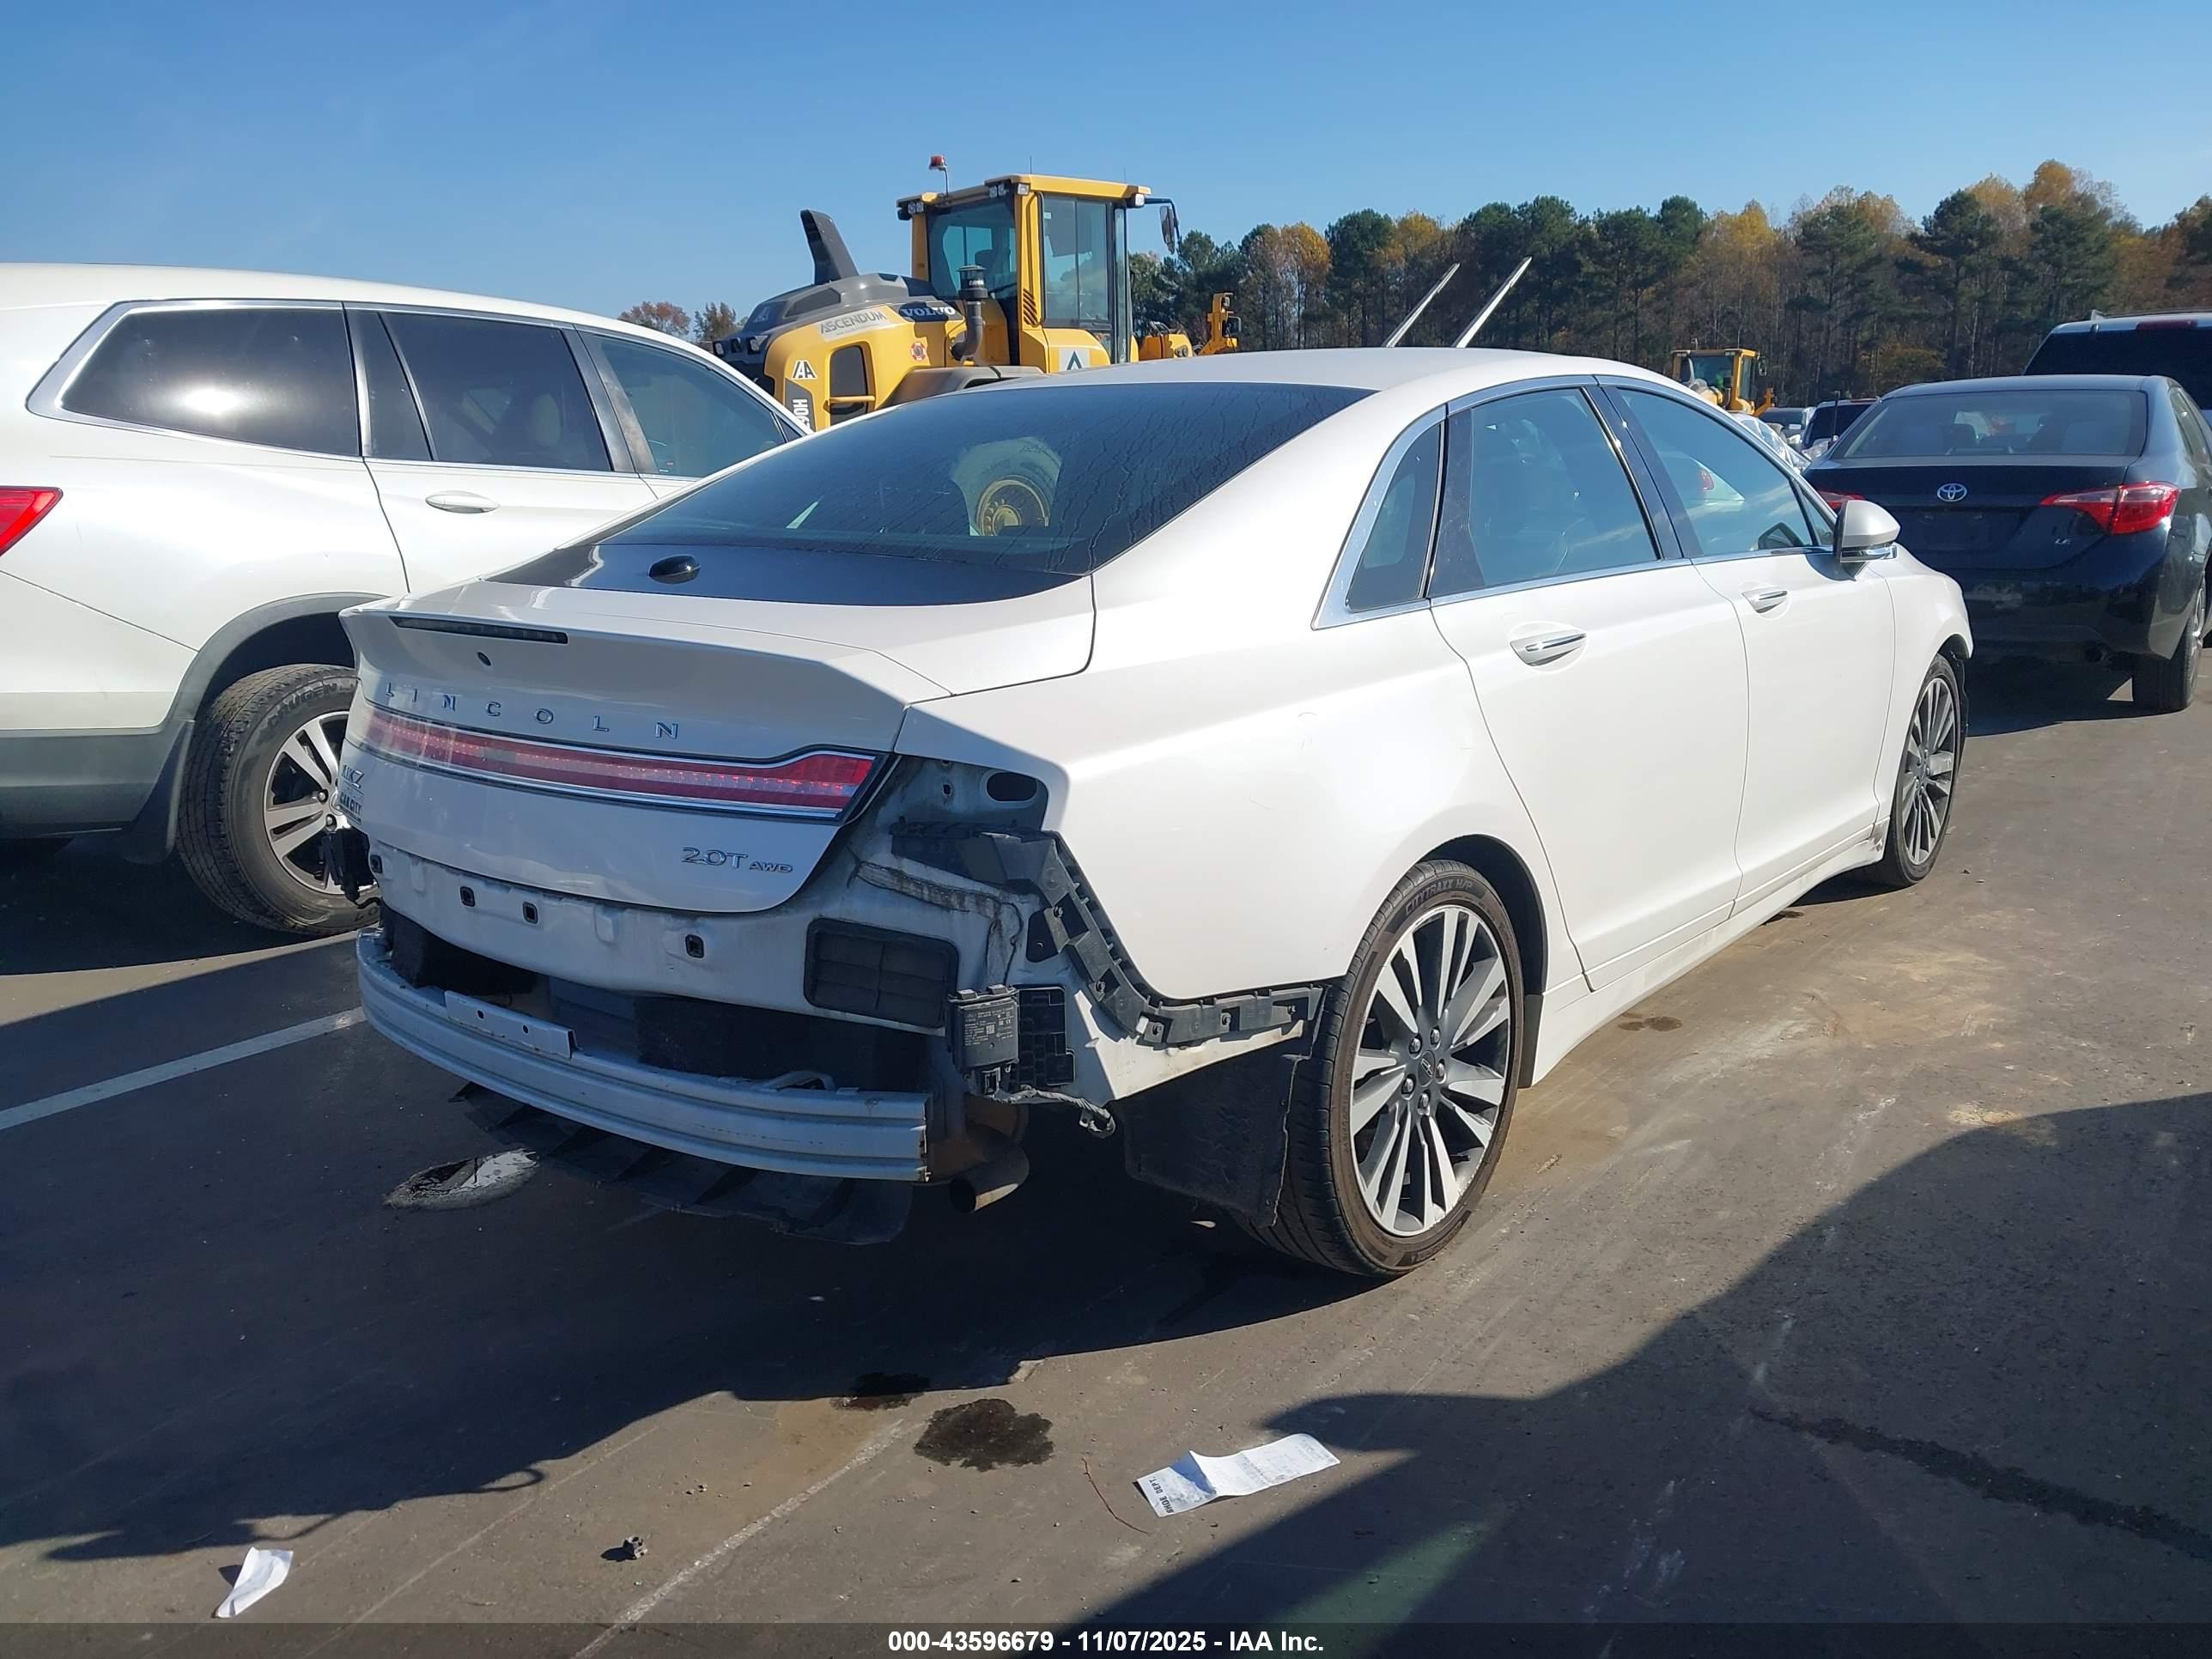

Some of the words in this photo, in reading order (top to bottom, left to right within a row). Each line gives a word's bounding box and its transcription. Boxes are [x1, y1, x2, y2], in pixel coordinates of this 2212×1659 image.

[900, 306, 957, 318] VOLVO
[819, 310, 887, 335] ASCENDUM
[386, 682, 679, 740] LINCOLN
[749, 860, 793, 873] AWD
